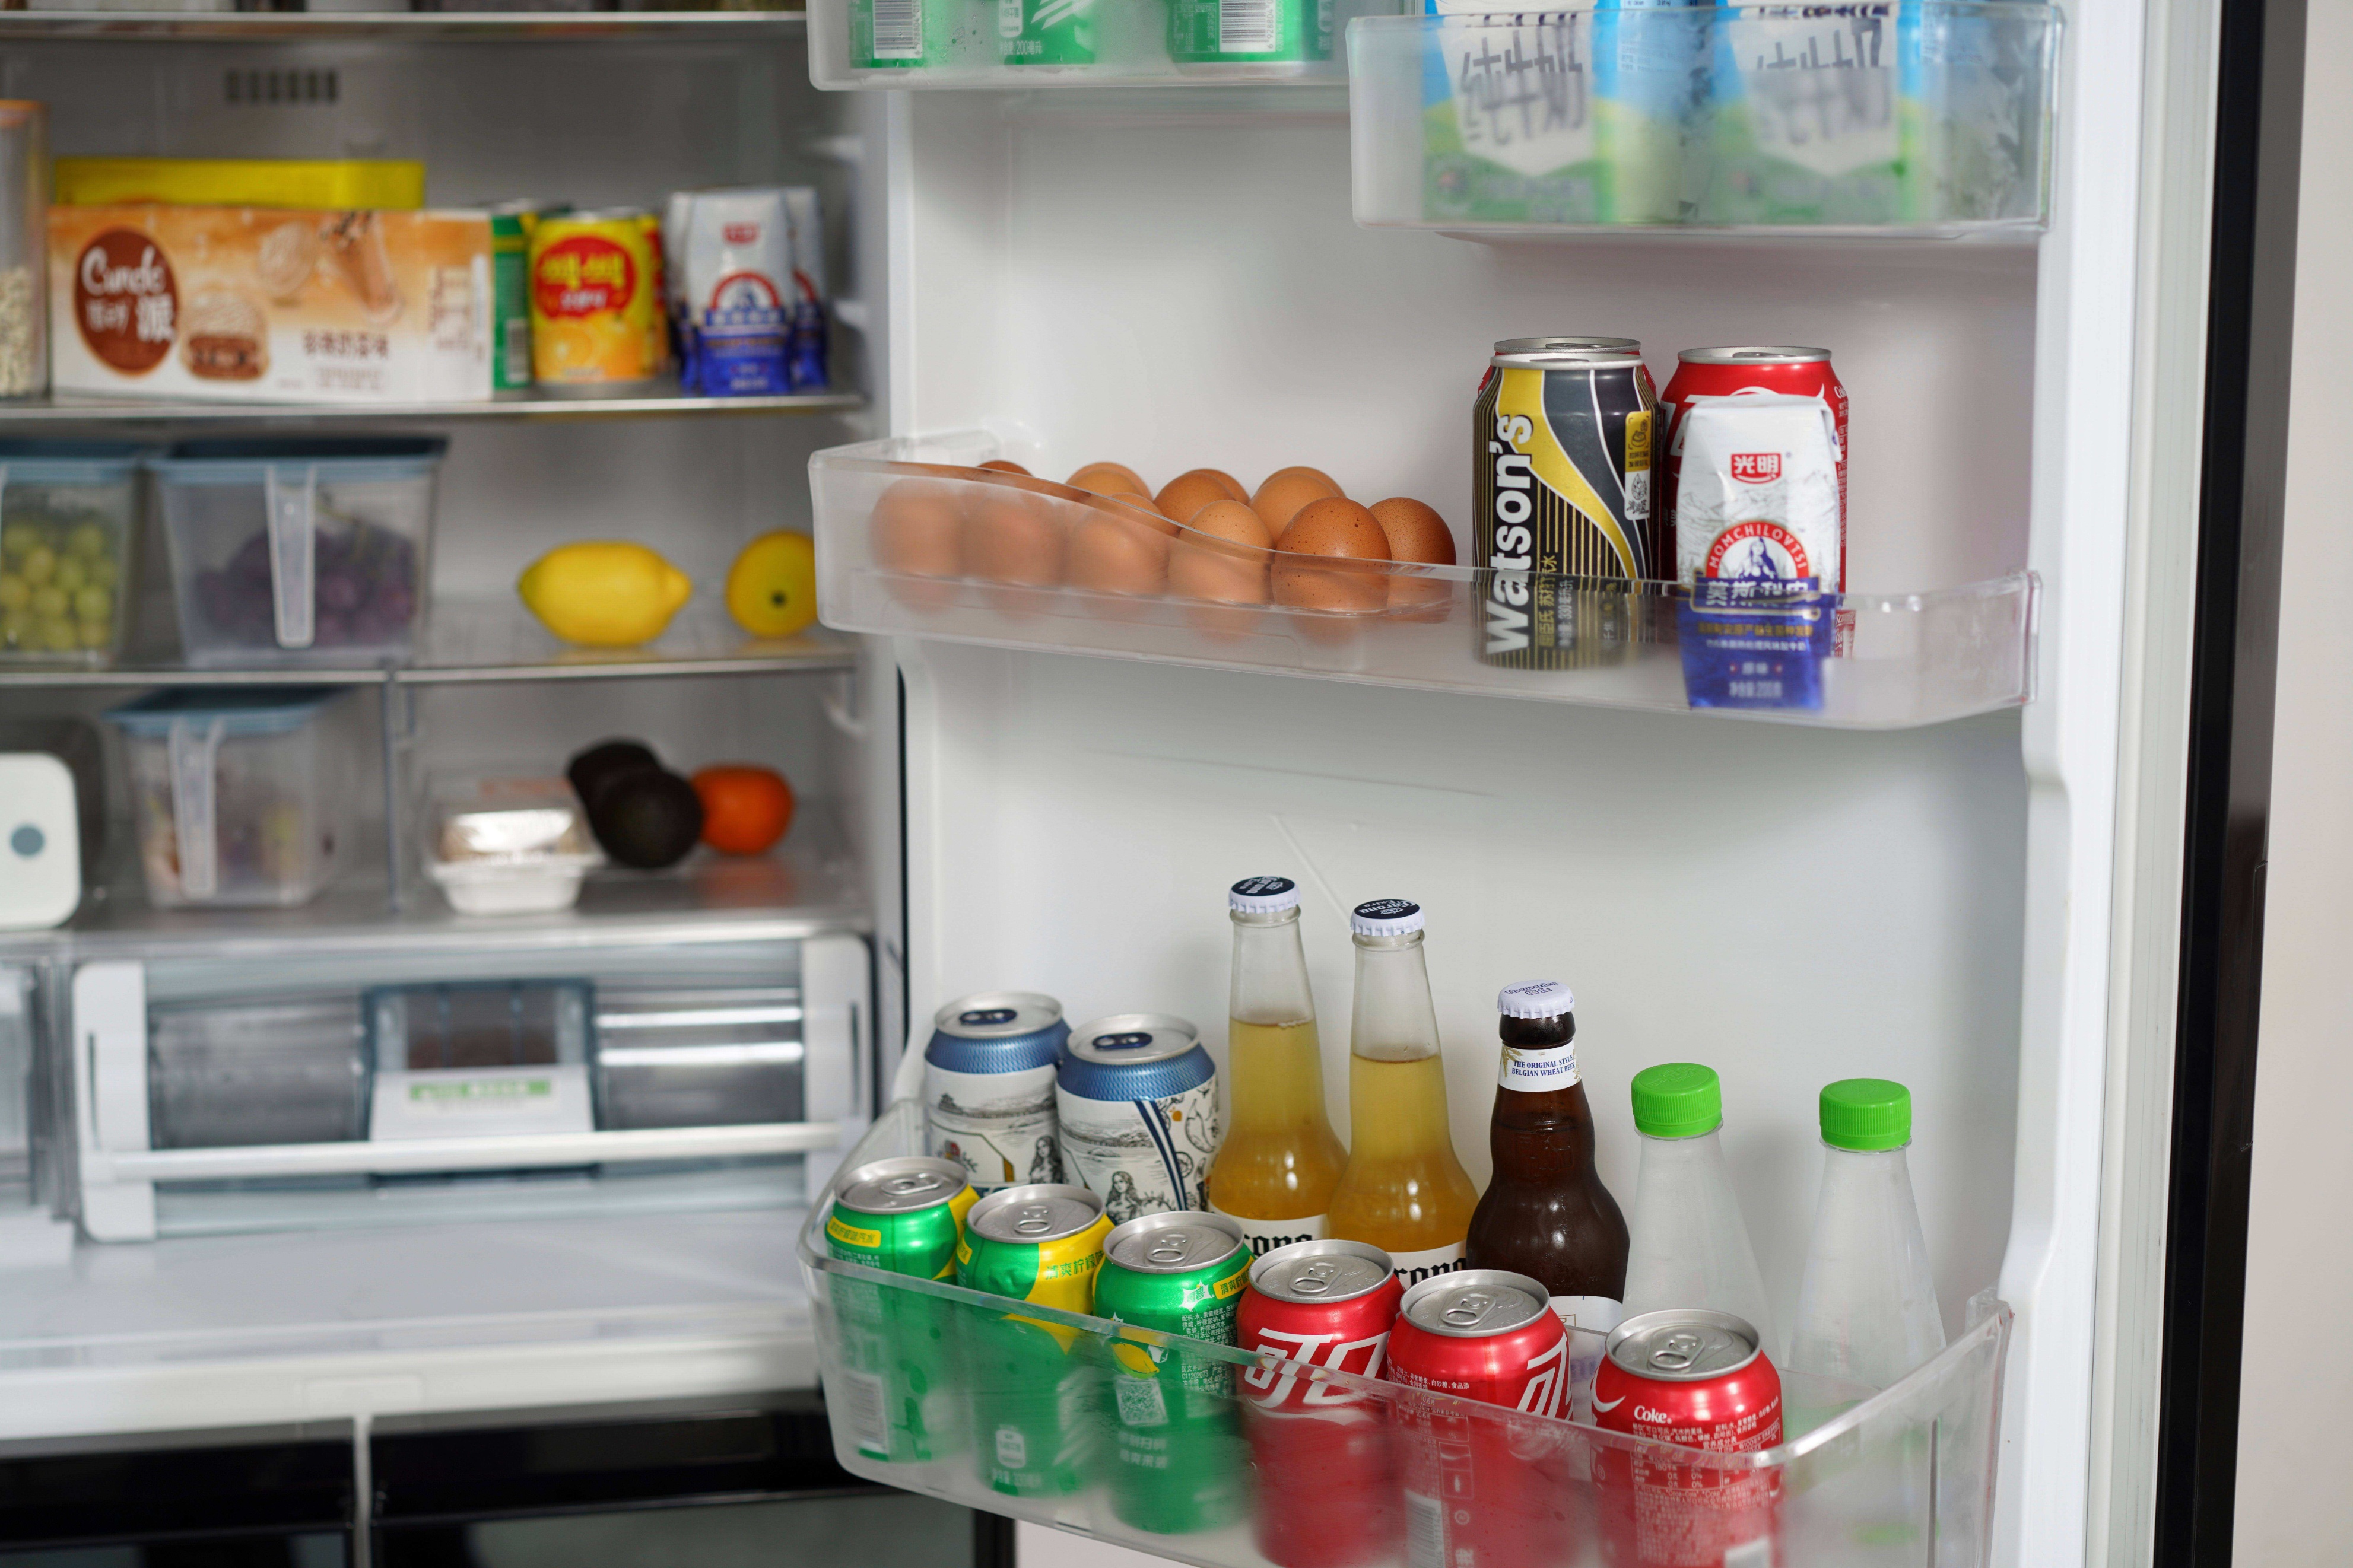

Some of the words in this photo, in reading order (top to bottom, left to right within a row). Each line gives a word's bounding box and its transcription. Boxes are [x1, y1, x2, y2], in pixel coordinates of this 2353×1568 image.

[1733, 455, 1779, 476] 光明
[1486, 414, 1533, 655] Watson's
[1709, 524, 1808, 569] MOMCHILOVTSI
[1358, 901, 1416, 914] Corona
[1558, 1054, 1573, 1066] STYLE
[1511, 1067, 1538, 1077] BELGIAN
[1541, 1067, 1563, 1076] WHEAT
[1633, 1405, 1668, 1424] Coke
